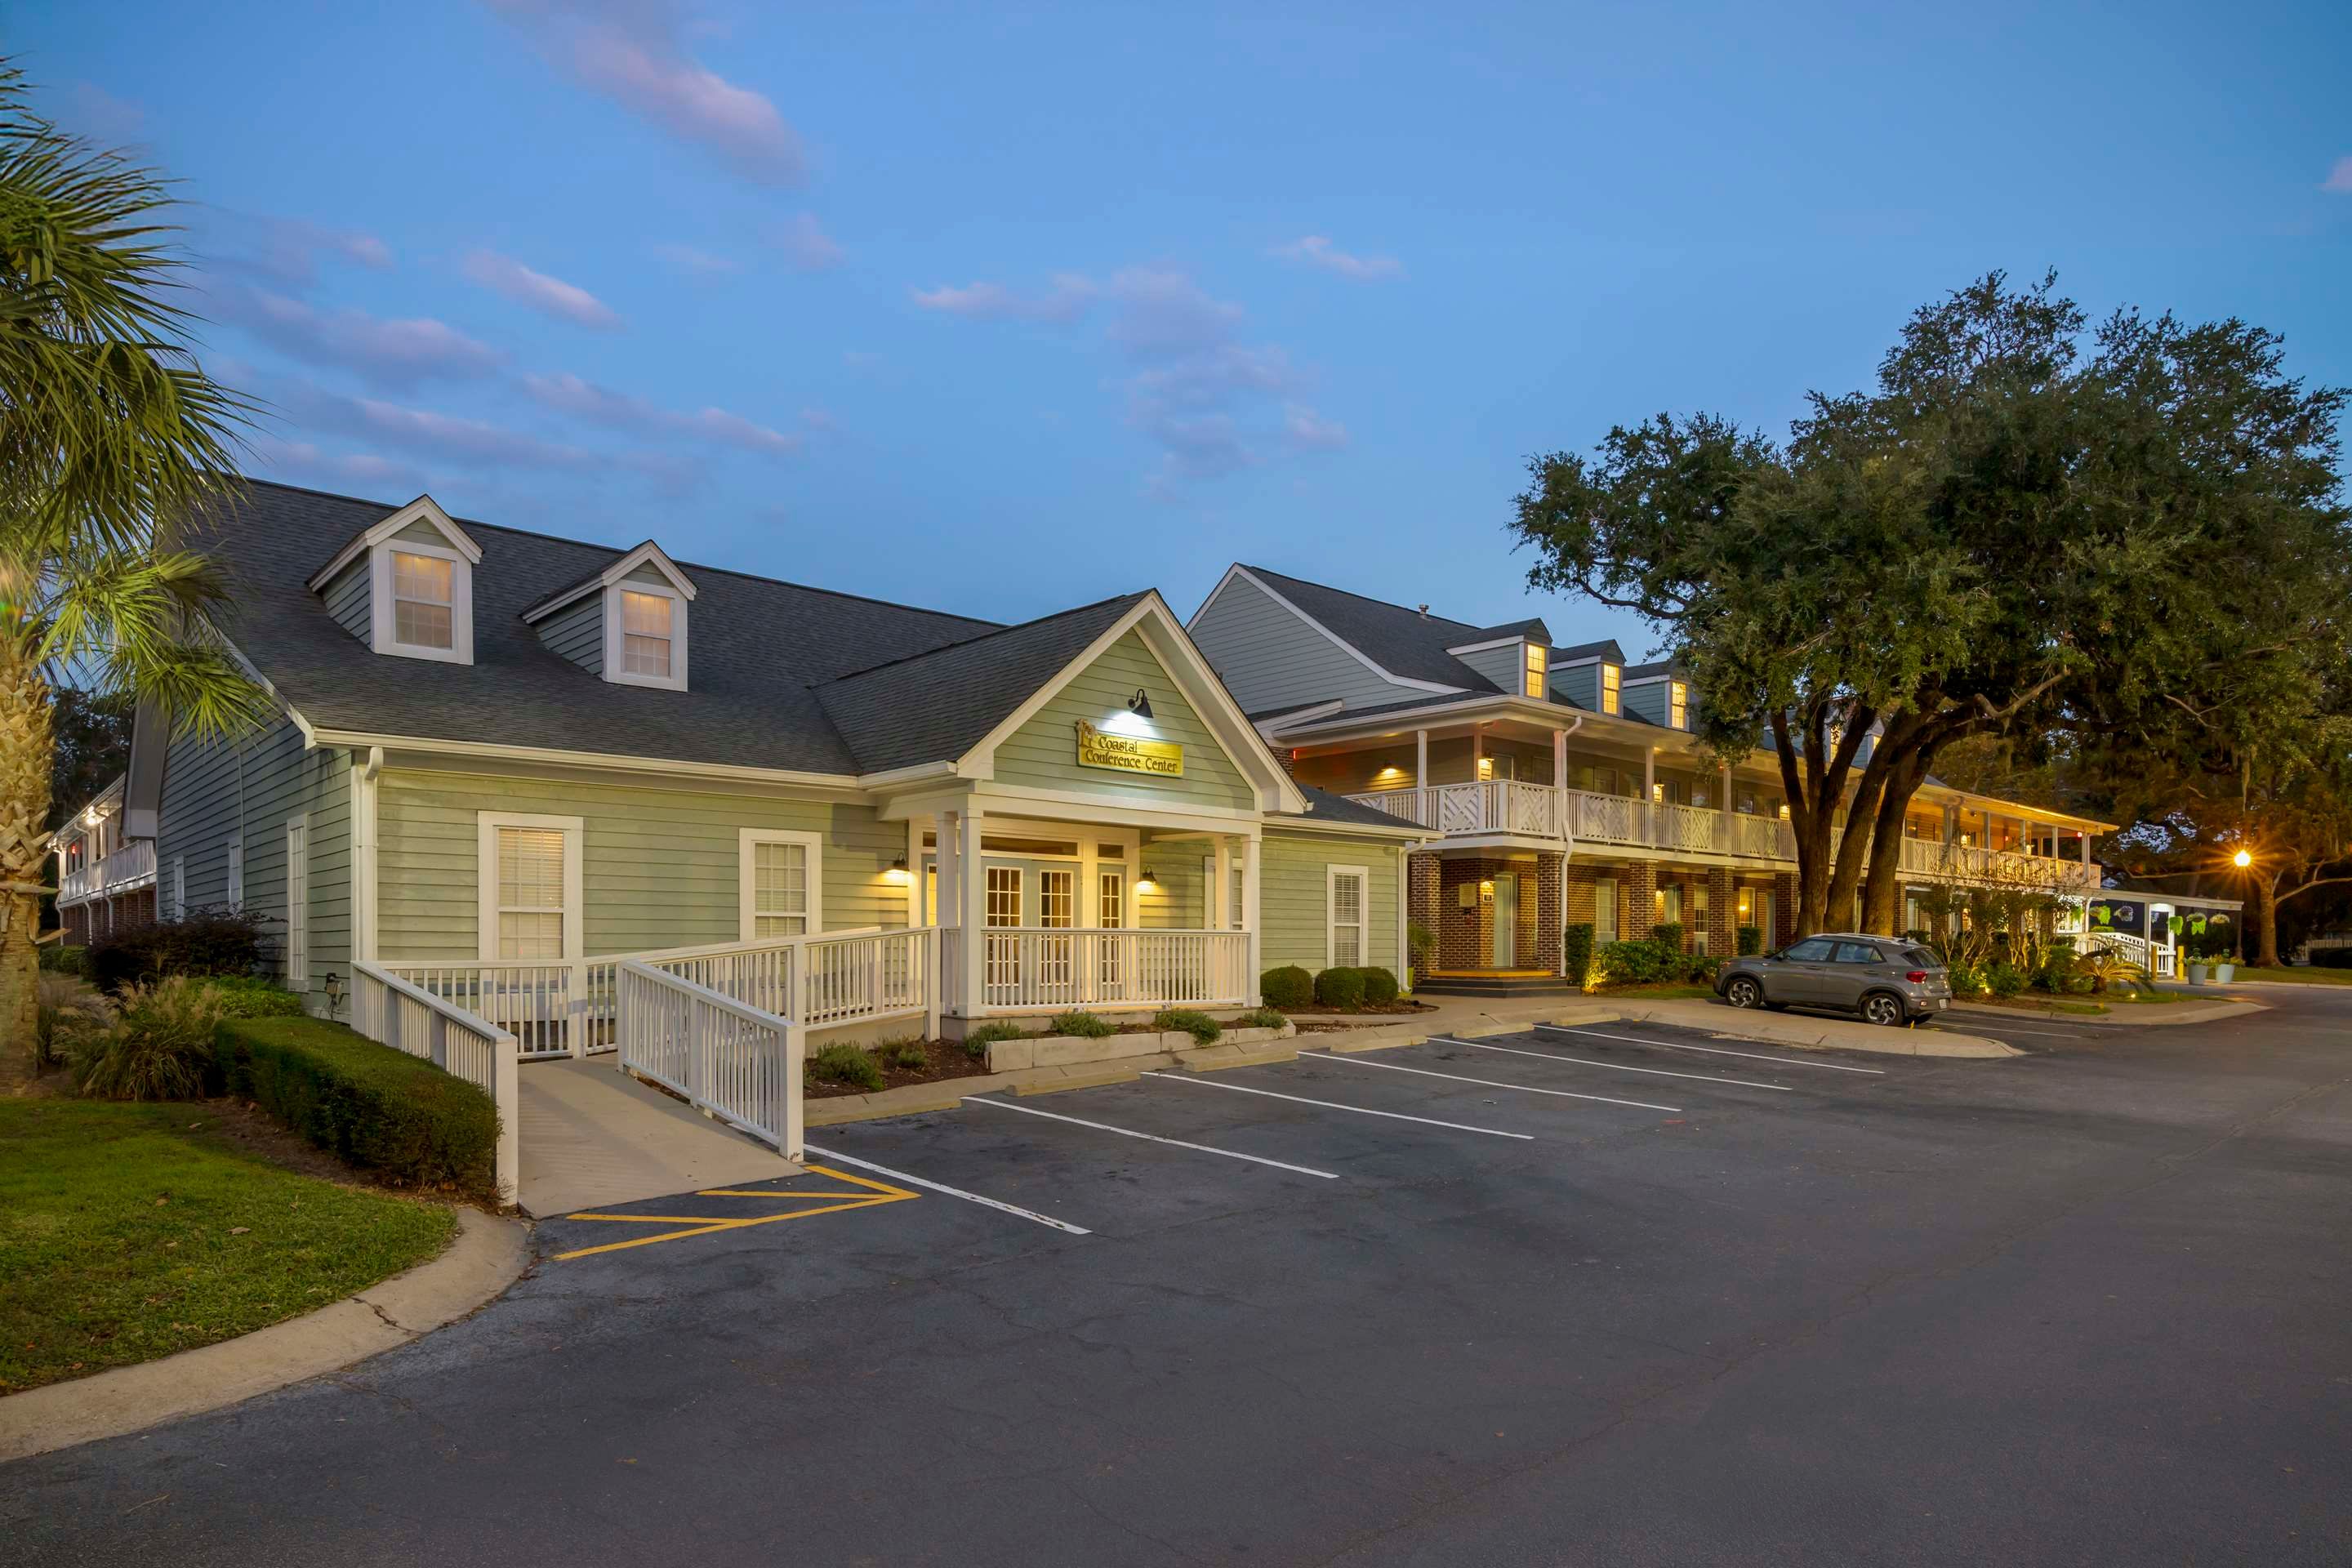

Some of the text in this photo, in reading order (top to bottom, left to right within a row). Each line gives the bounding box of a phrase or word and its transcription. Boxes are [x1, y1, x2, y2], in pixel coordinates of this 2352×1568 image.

[1098, 737, 1138, 753] Coastal
[1085, 750, 1177, 773] Conference Center
